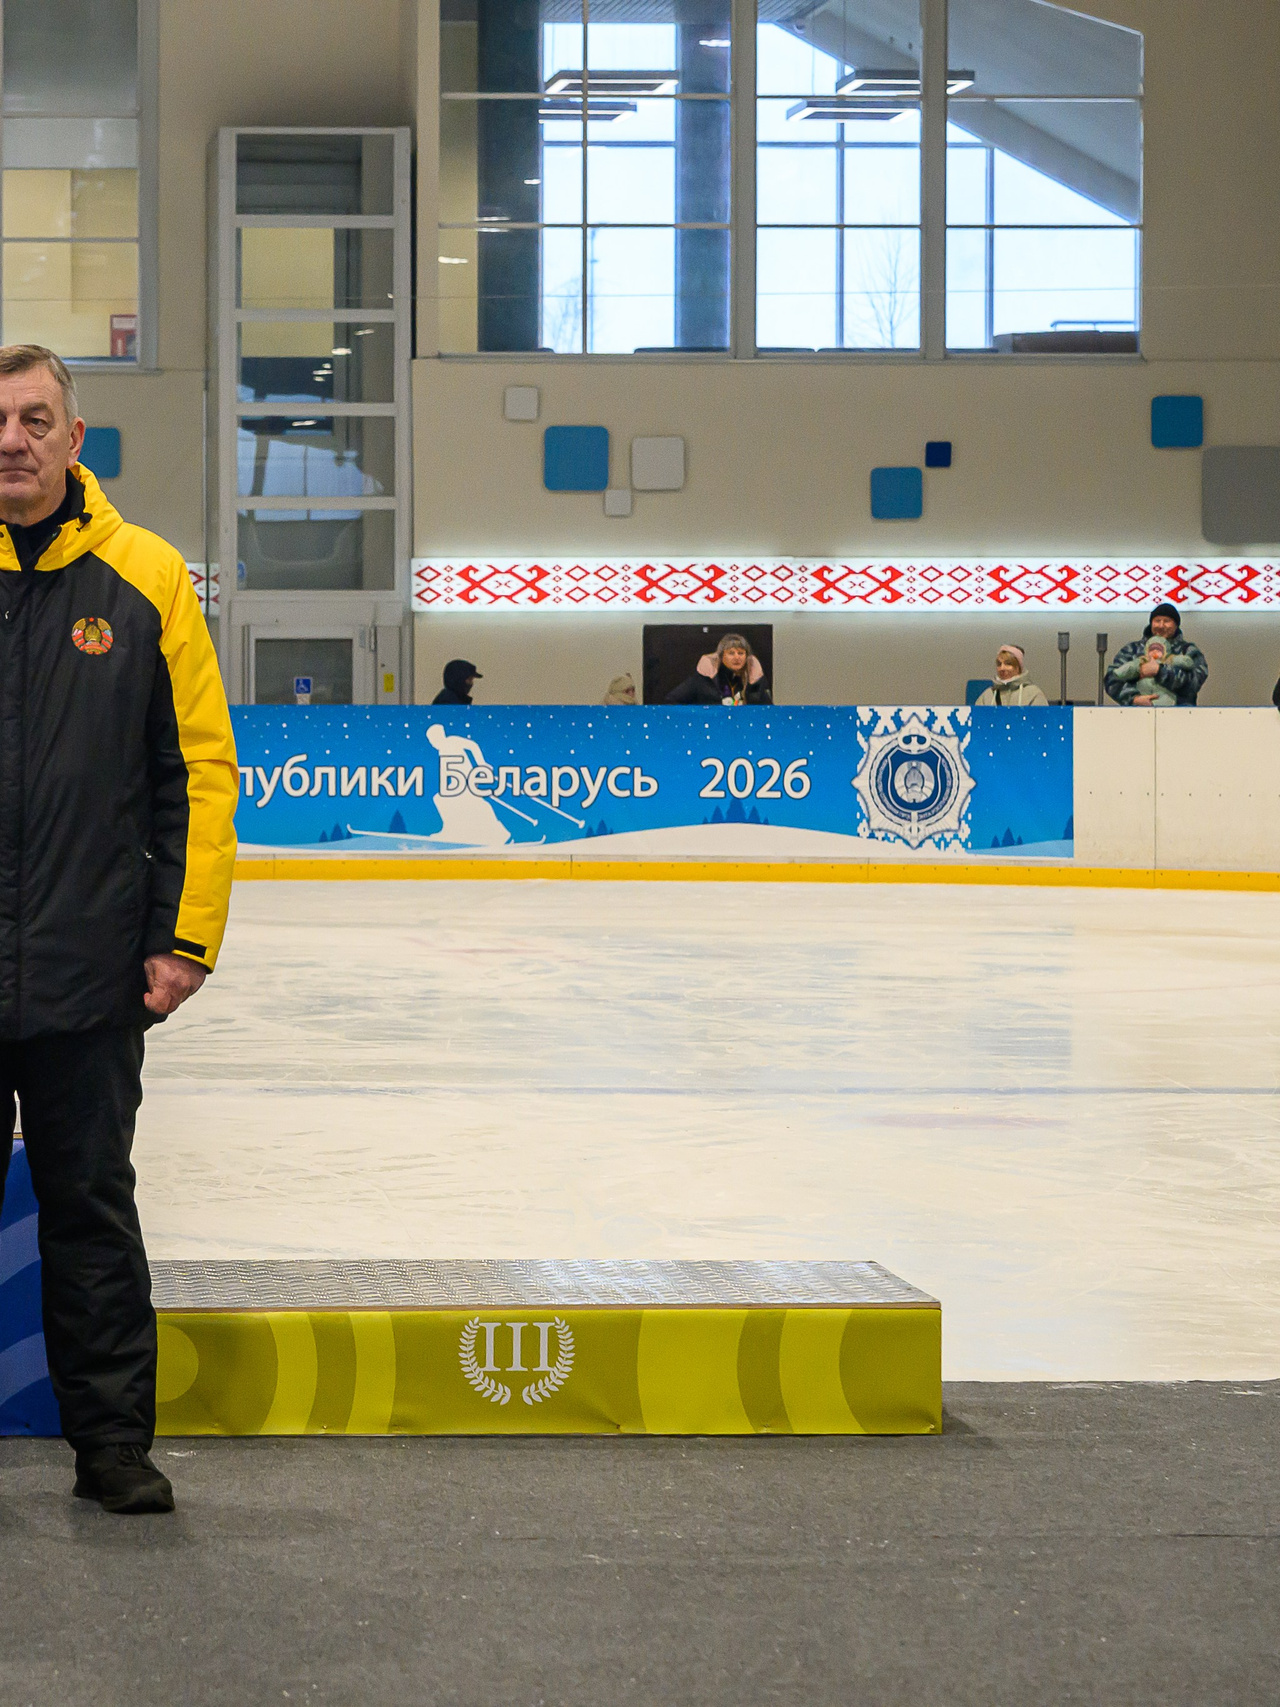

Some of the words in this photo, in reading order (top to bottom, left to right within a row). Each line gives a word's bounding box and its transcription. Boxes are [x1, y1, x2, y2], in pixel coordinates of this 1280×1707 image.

[438, 755, 659, 808] Беларусь
[699, 757, 811, 799] 2026
[479, 1322, 556, 1371] III
